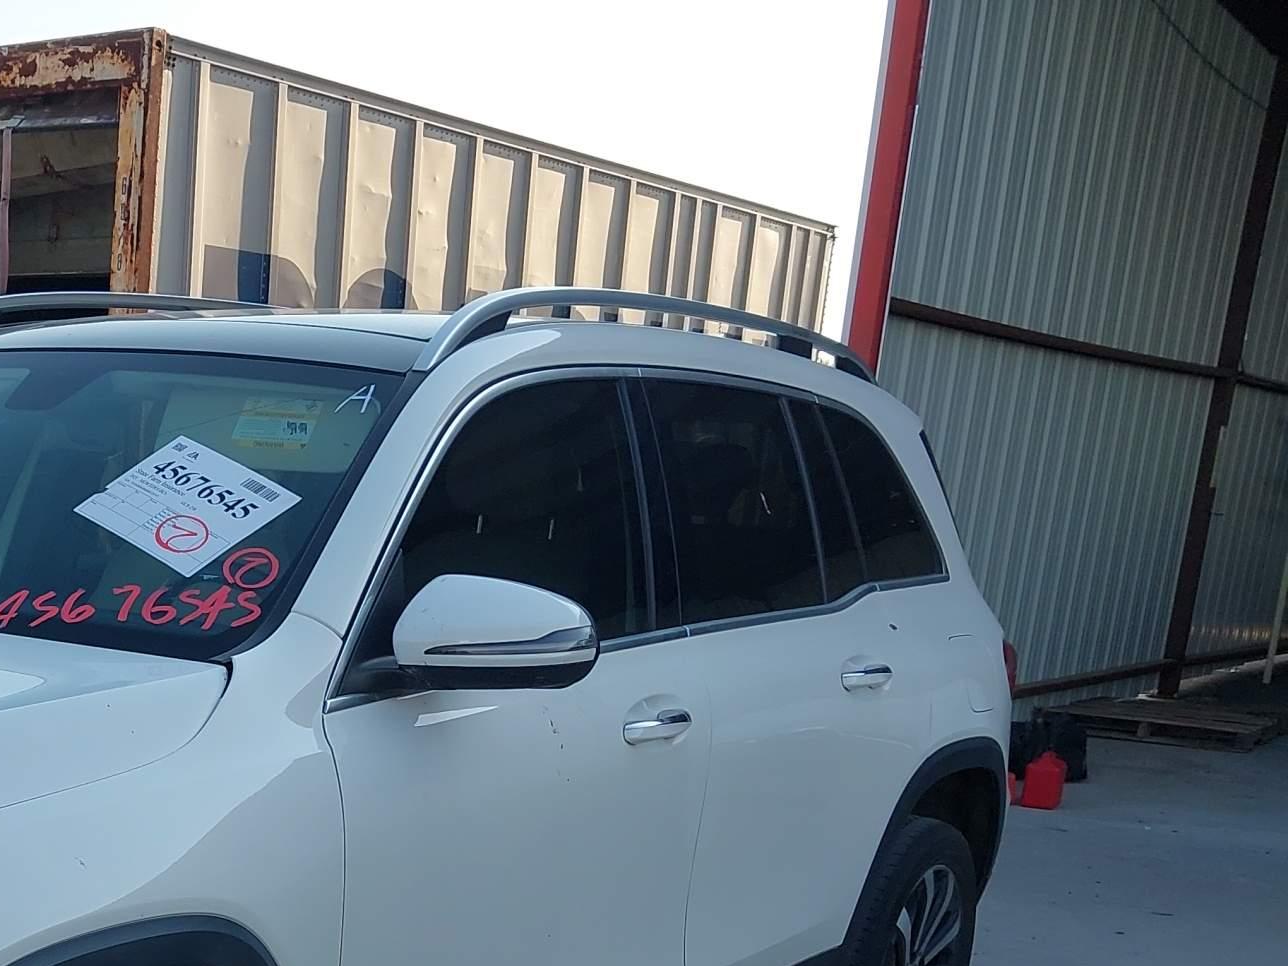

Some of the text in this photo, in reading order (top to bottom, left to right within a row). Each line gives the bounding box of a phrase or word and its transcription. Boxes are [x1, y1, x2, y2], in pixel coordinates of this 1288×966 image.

[334, 384, 376, 414] A
[152, 460, 260, 520] 45676545
[112, 583, 262, 631] 76545
